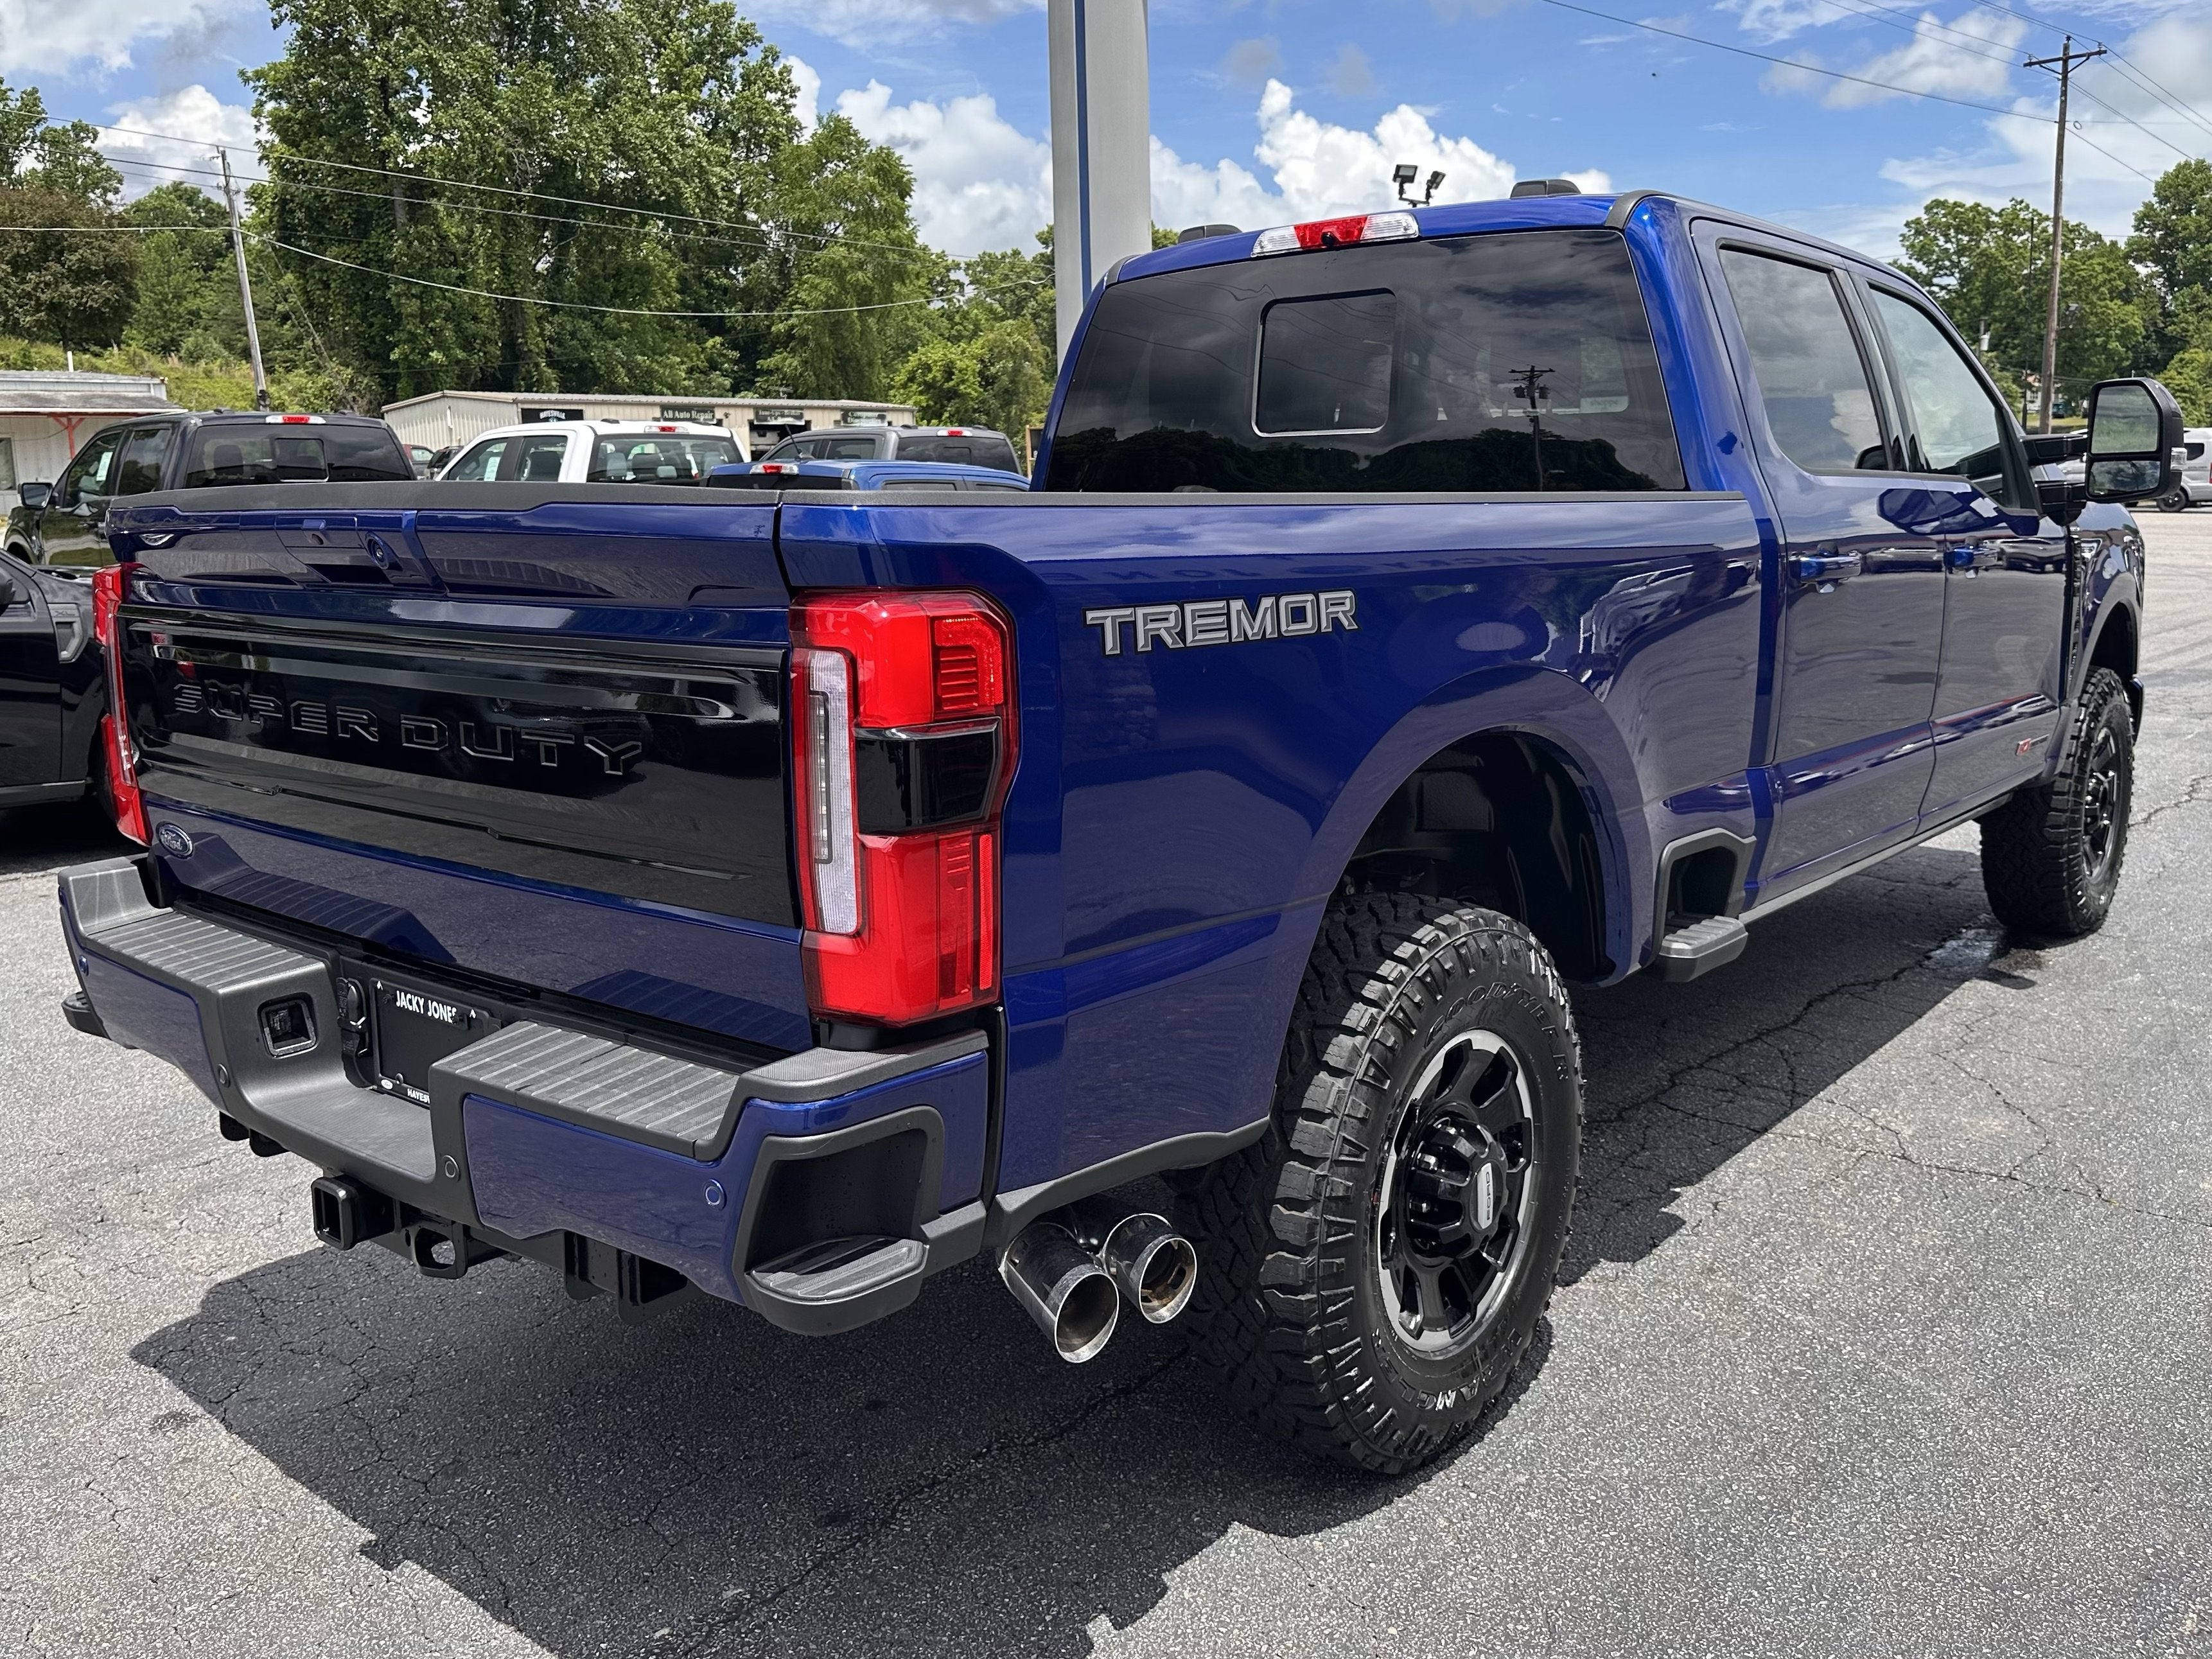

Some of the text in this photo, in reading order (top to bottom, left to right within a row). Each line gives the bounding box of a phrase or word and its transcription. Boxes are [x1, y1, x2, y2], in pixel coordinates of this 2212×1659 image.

[663, 410, 714, 421] All Auto Repair
[1085, 590, 1358, 656] TREMOR
[174, 684, 643, 775] SUPER DUTY
[161, 829, 183, 850] Ford
[396, 990, 425, 1015] JACKY
[1424, 981, 1569, 1080] GOODYEAR
